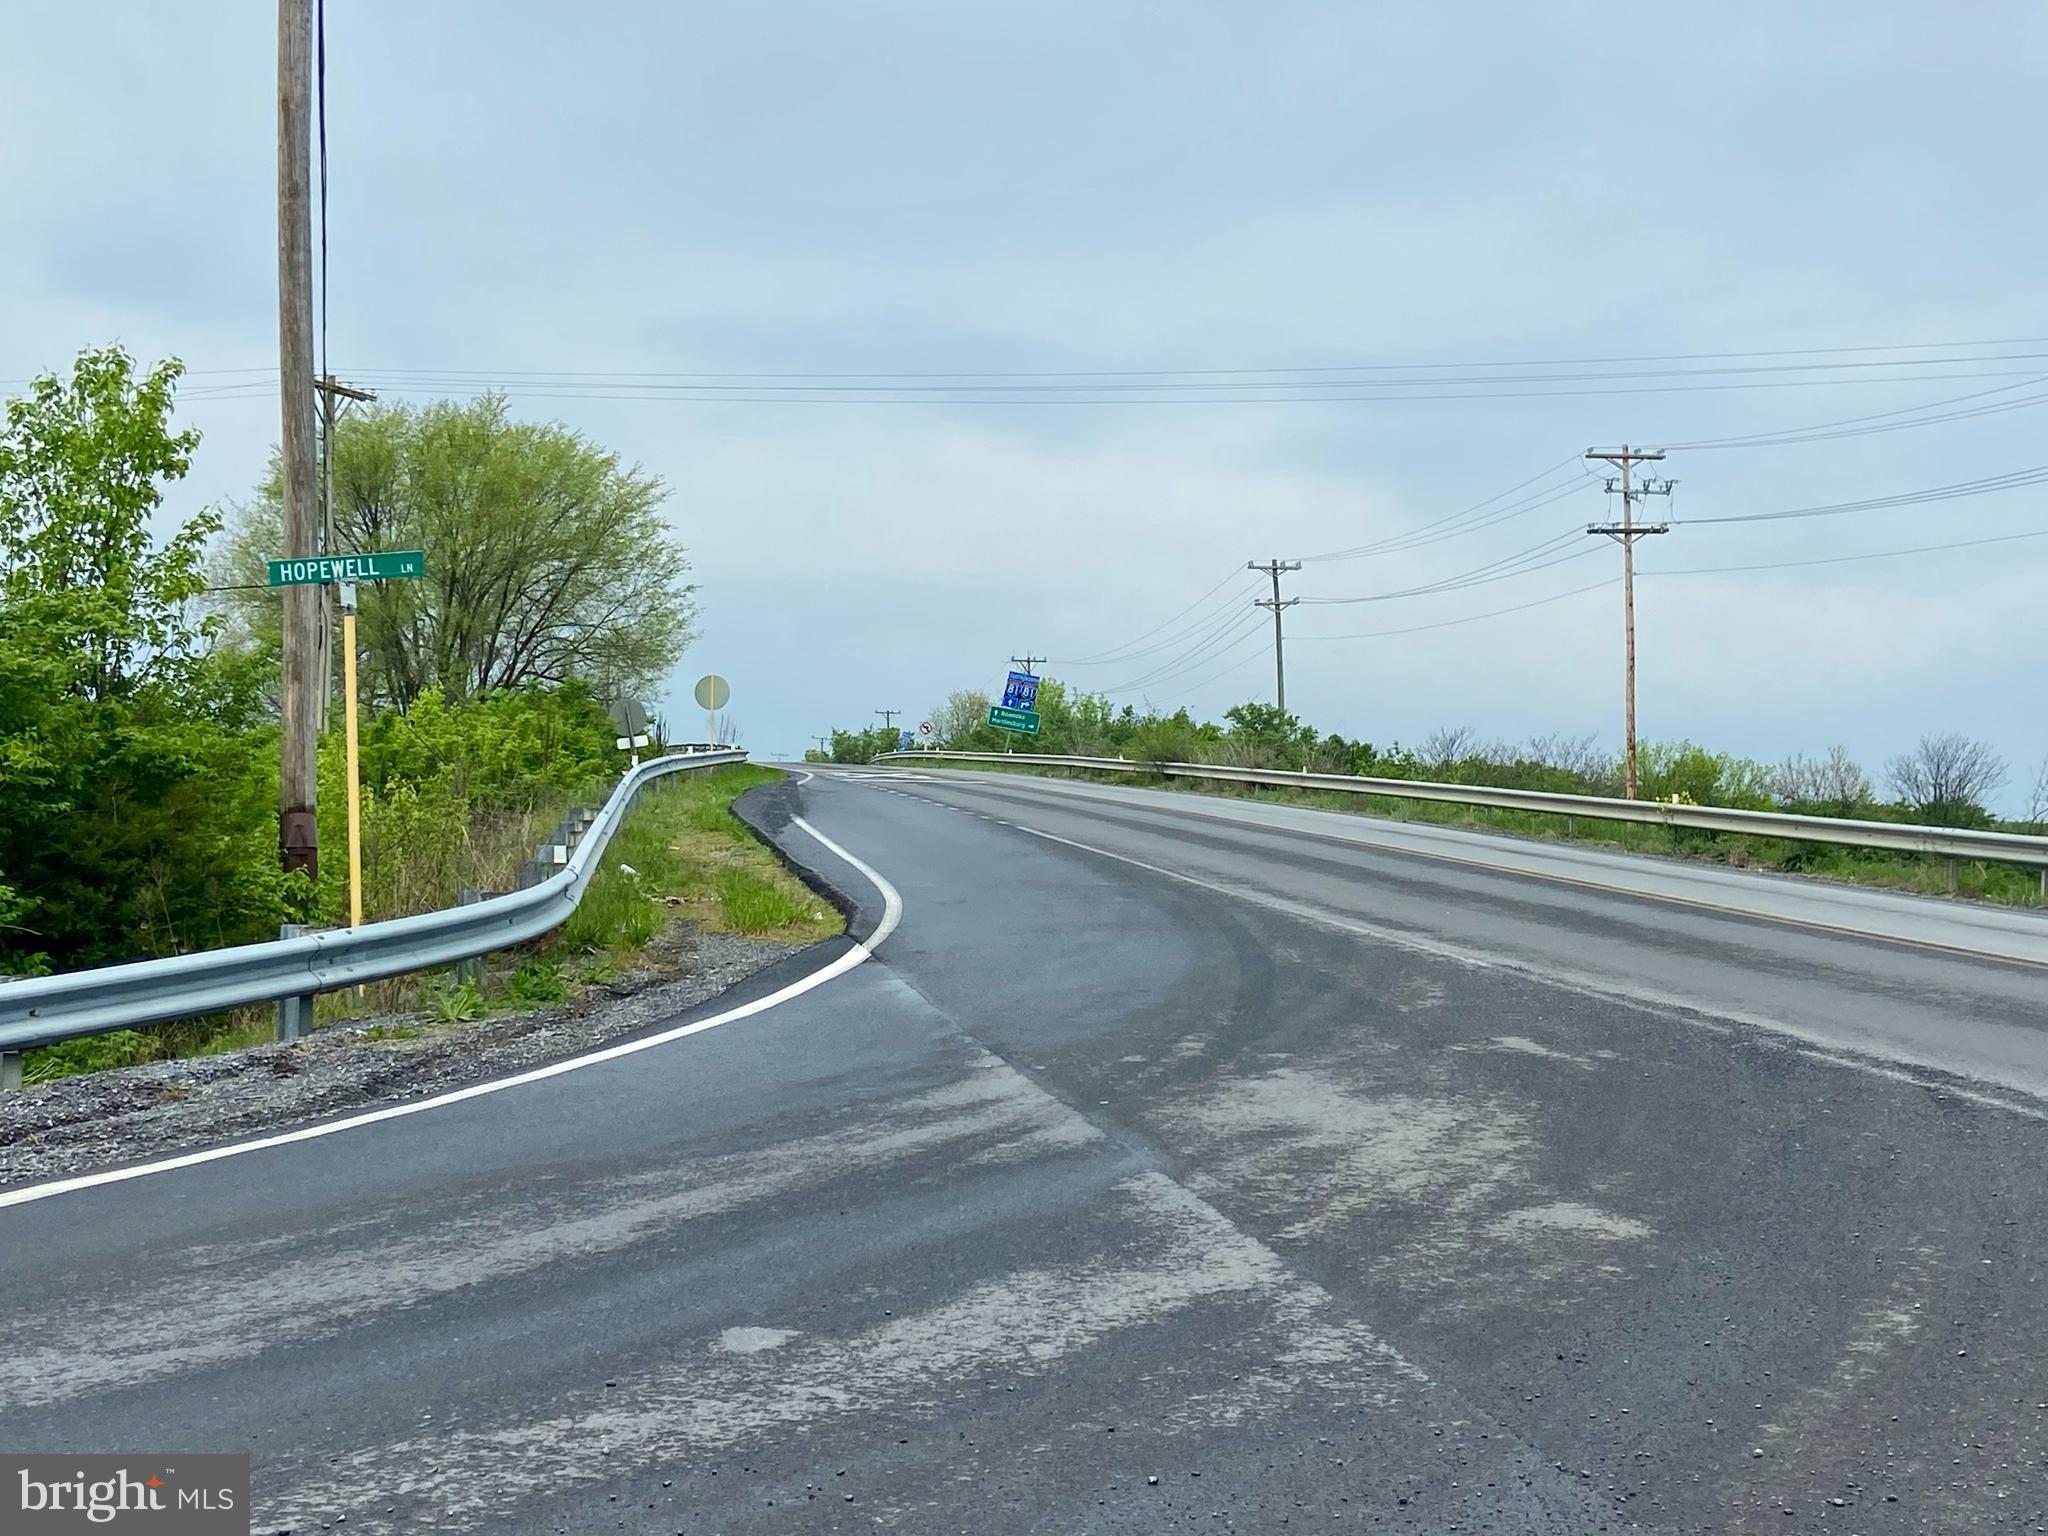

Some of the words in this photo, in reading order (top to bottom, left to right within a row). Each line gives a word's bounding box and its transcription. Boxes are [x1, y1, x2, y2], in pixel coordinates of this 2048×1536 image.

[280, 557, 380, 582] HOPEWELL
[400, 563, 414, 574] LN
[1007, 684, 1019, 694] 81
[1023, 687, 1034, 698] 81
